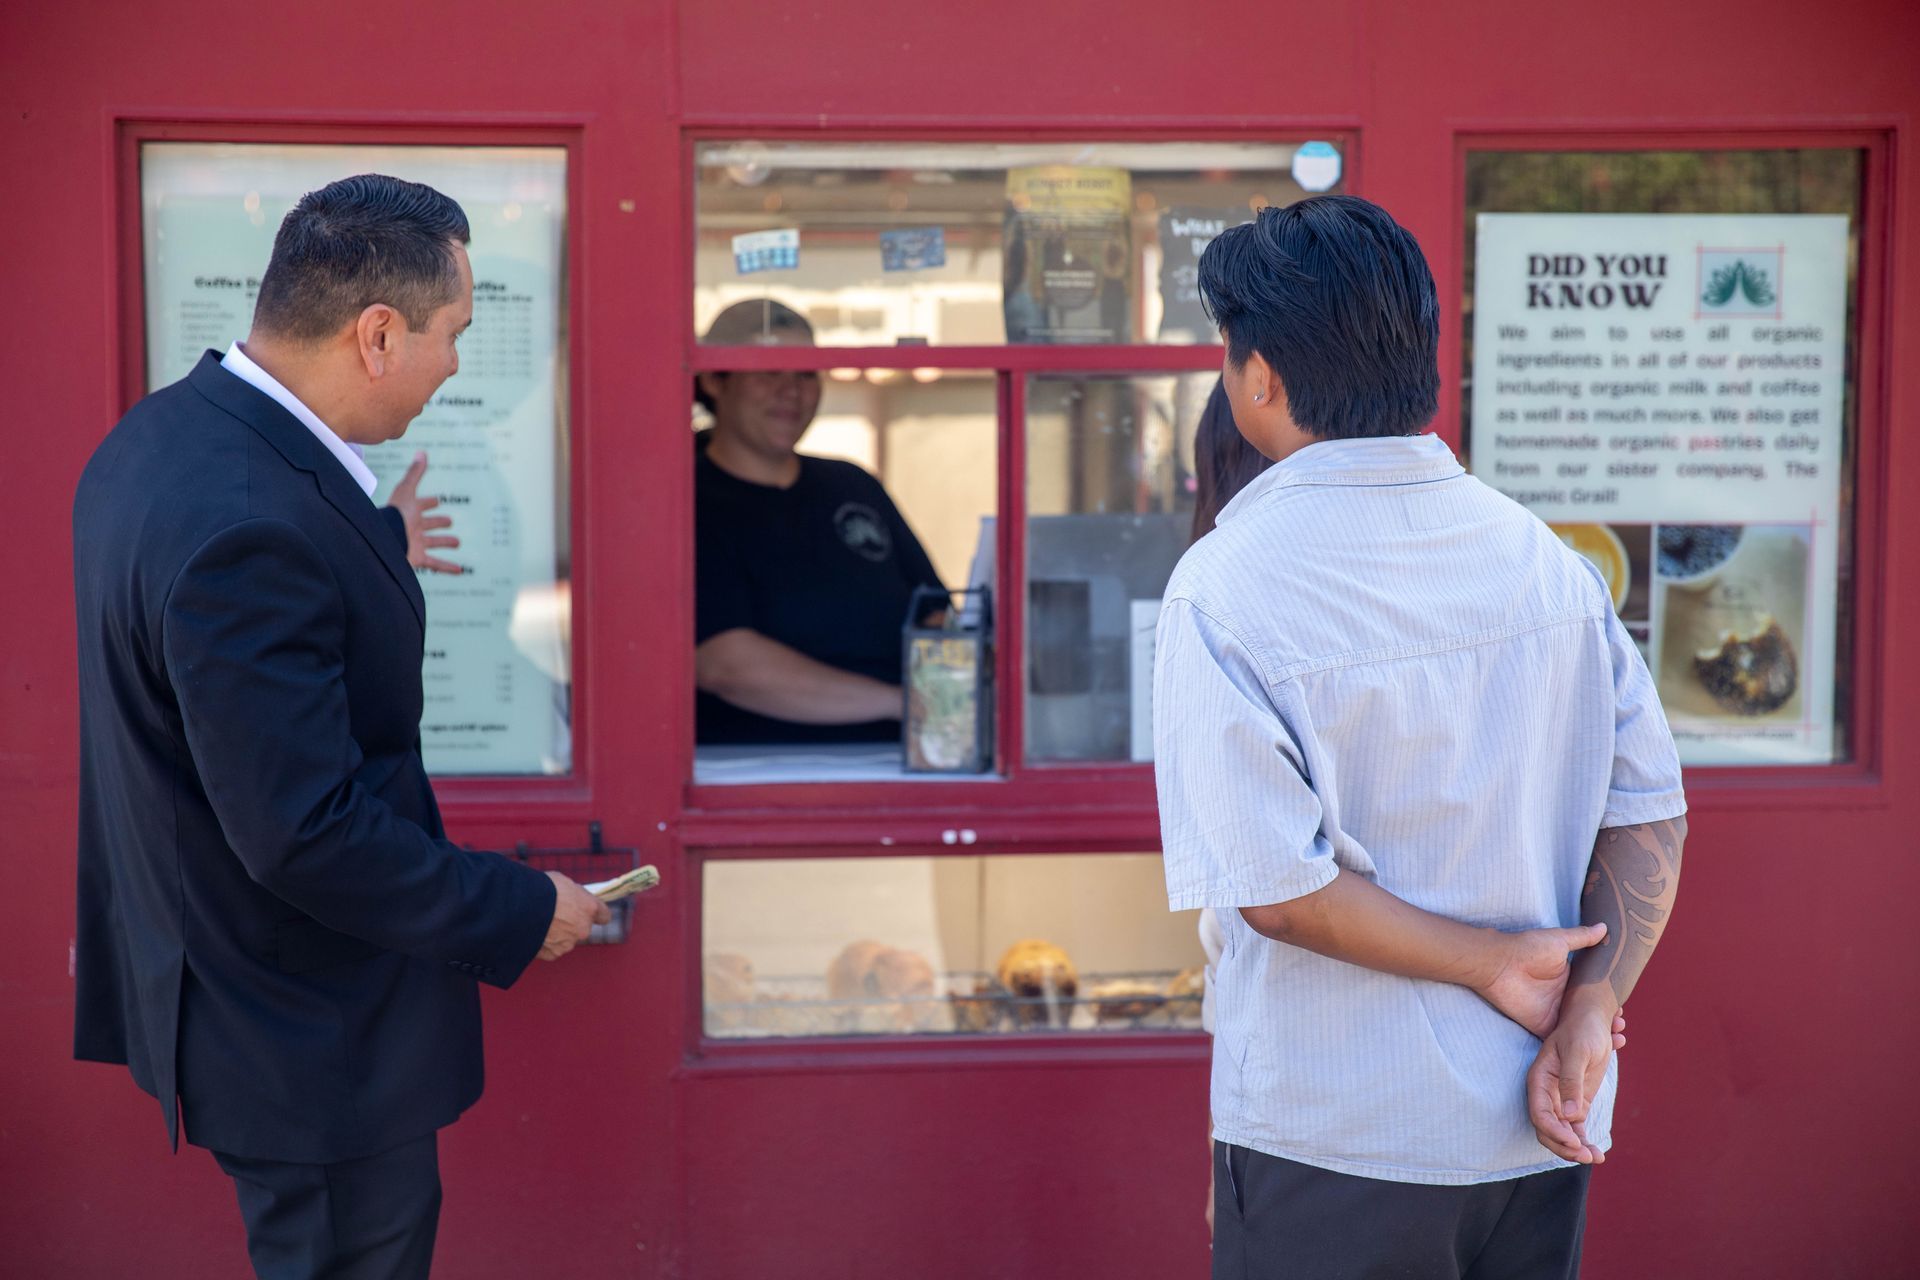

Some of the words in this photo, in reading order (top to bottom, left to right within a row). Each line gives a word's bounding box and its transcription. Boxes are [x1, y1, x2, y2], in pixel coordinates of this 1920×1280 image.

[1528, 254, 1586, 278] DID
[1596, 254, 1668, 278] YOU
[1527, 283, 1662, 309] KNOW
[1498, 326, 1528, 340] We
[1550, 326, 1585, 340] aim
[1608, 327, 1628, 340] to
[1651, 328, 1684, 340] use
[1708, 326, 1729, 340] all
[1752, 326, 1822, 343] organic
[1497, 353, 1602, 371] ingredients
[1611, 353, 1629, 367] in
[1638, 353, 1659, 367] all
[1668, 353, 1688, 367] of
[1696, 355, 1728, 367] our
[1738, 353, 1822, 370] products
[1496, 381, 1581, 398] including
[1590, 381, 1659, 398] organic
[1669, 381, 1707, 394] milk
[1717, 381, 1752, 394] and
[1761, 381, 1821, 394] coffee
[1496, 410, 1517, 422] as
[1524, 408, 1561, 422] well
[1567, 410, 1588, 422] as
[1594, 408, 1646, 422] much
[1652, 410, 1704, 423] more.
[1711, 408, 1739, 422] We
[1746, 408, 1783, 422] also
[1789, 409, 1819, 426] get
[1495, 435, 1599, 449] homemade
[1609, 435, 1678, 452] organic
[1689, 435, 1764, 452] pastries
[1774, 435, 1819, 452] daily
[1494, 462, 1540, 477] from
[1557, 464, 1588, 477] our
[1607, 462, 1658, 477] sister
[1786, 462, 1818, 477] The
[1500, 489, 1567, 505] rganic
